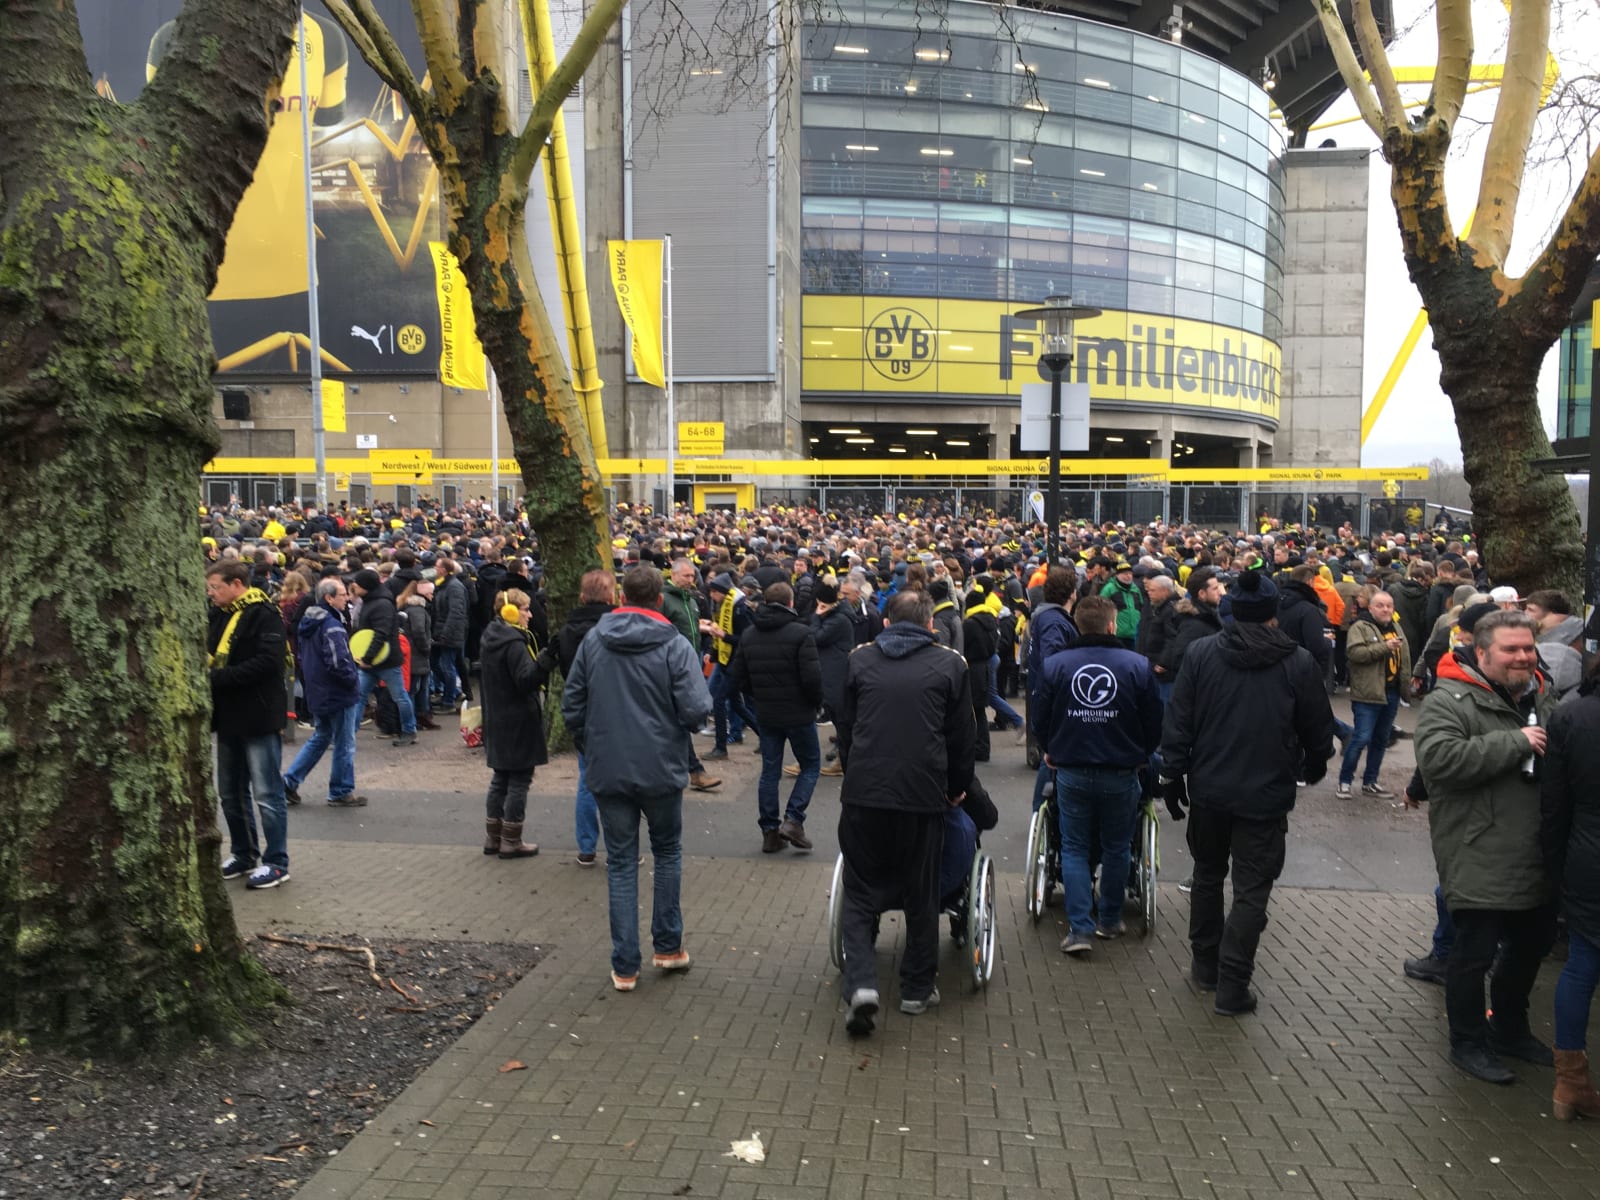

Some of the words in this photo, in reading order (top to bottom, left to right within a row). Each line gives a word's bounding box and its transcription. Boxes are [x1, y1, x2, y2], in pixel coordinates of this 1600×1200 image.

[401, 328, 422, 345] BVB
[875, 314, 930, 360] BVB
[890, 359, 912, 375] 09
[687, 427, 716, 437] 64-68
[382, 461, 420, 470] Nordwest
[427, 462, 447, 470] West
[454, 461, 487, 471] Südwest
